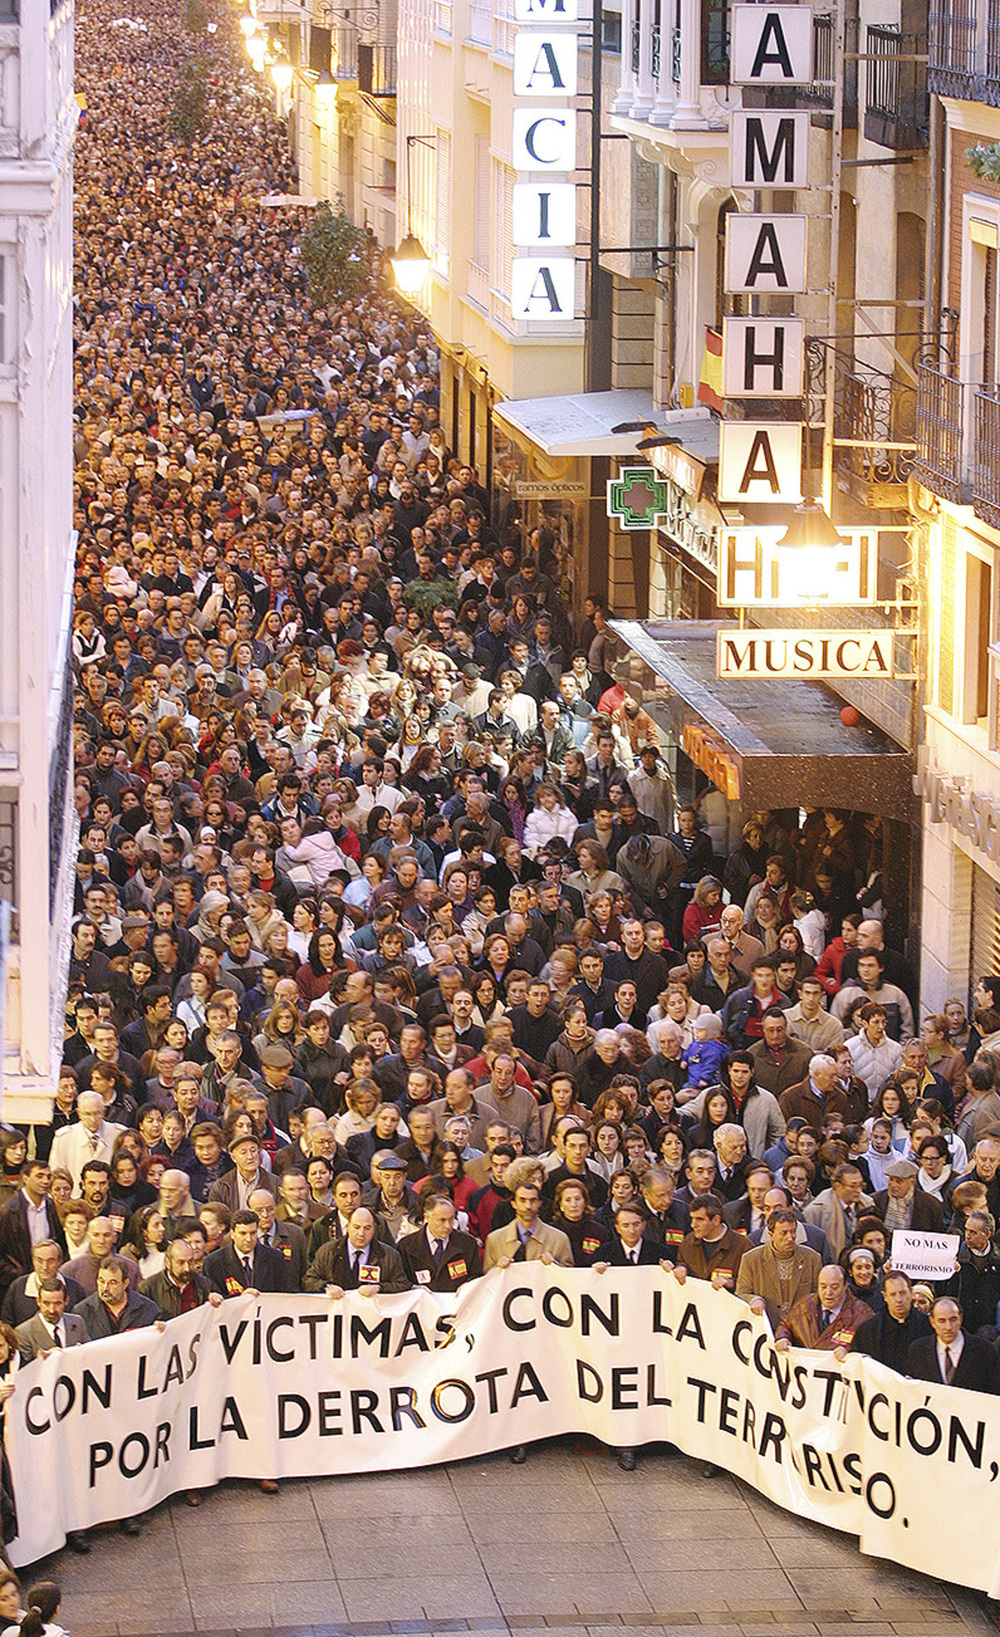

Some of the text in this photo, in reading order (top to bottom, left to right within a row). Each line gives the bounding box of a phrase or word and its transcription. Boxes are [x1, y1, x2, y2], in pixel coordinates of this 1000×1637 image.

[523, 0, 567, 312] ACIA
[723, 640, 888, 672] MUSICA
[895, 1263, 953, 1273] TERRORISMO
[904, 1238, 948, 1250] NO MAS
[25, 1364, 112, 1436] CON
[137, 1333, 201, 1400] LAS
[219, 1306, 475, 1366] VÍCTIMAS,
[502, 1287, 620, 1337] CON
[652, 1290, 706, 1350] LA
[89, 1421, 171, 1488] POR
[189, 1396, 249, 1450] LA
[277, 1361, 550, 1440] DERROTA
[575, 1359, 672, 1411] DEL
